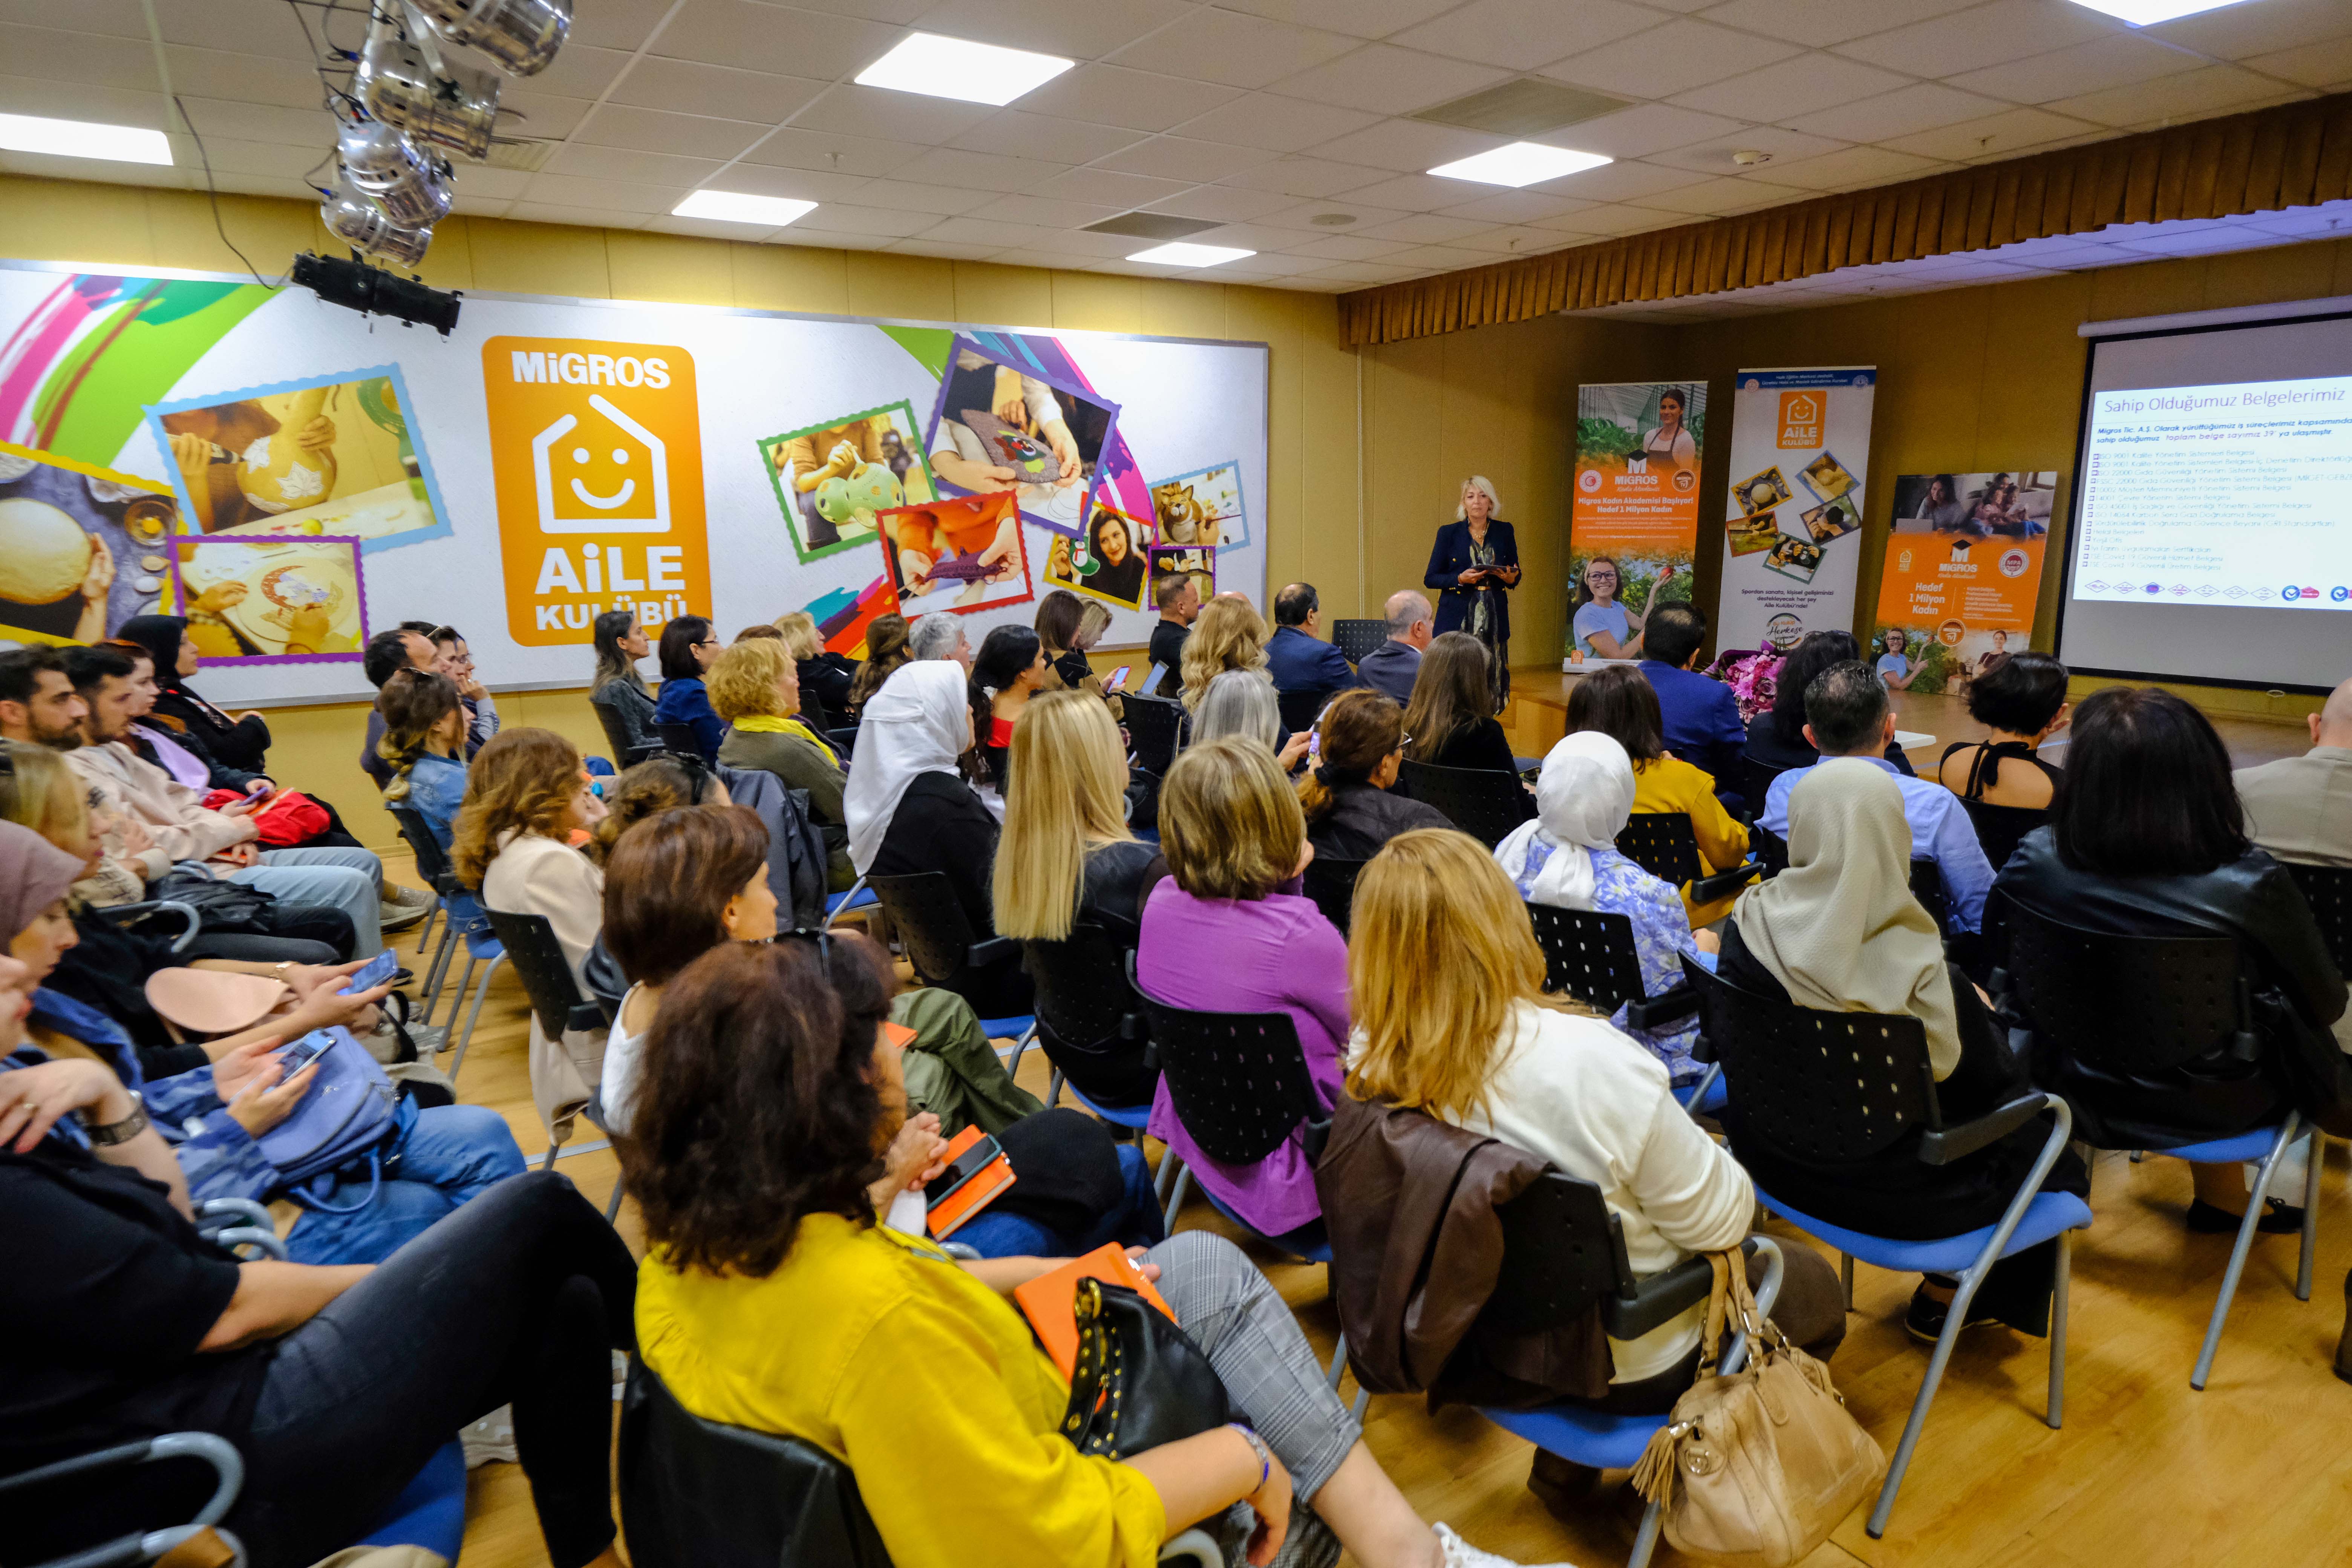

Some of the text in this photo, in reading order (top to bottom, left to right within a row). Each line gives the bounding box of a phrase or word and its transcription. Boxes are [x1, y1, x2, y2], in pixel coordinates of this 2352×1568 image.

[2105, 387, 2345, 413] Sahip Olduğumuz Belgelerimiz
[2298, 418, 2352, 427] kapsamında
[1663, 497, 1694, 505] Başlıyor!
[1626, 506, 1649, 514] Milyon
[1916, 582, 1943, 592] Hedef
[1909, 593, 1945, 605] 1 Milyon
[1913, 605, 1938, 614] Kadın
[1766, 626, 1803, 636] Herkese
